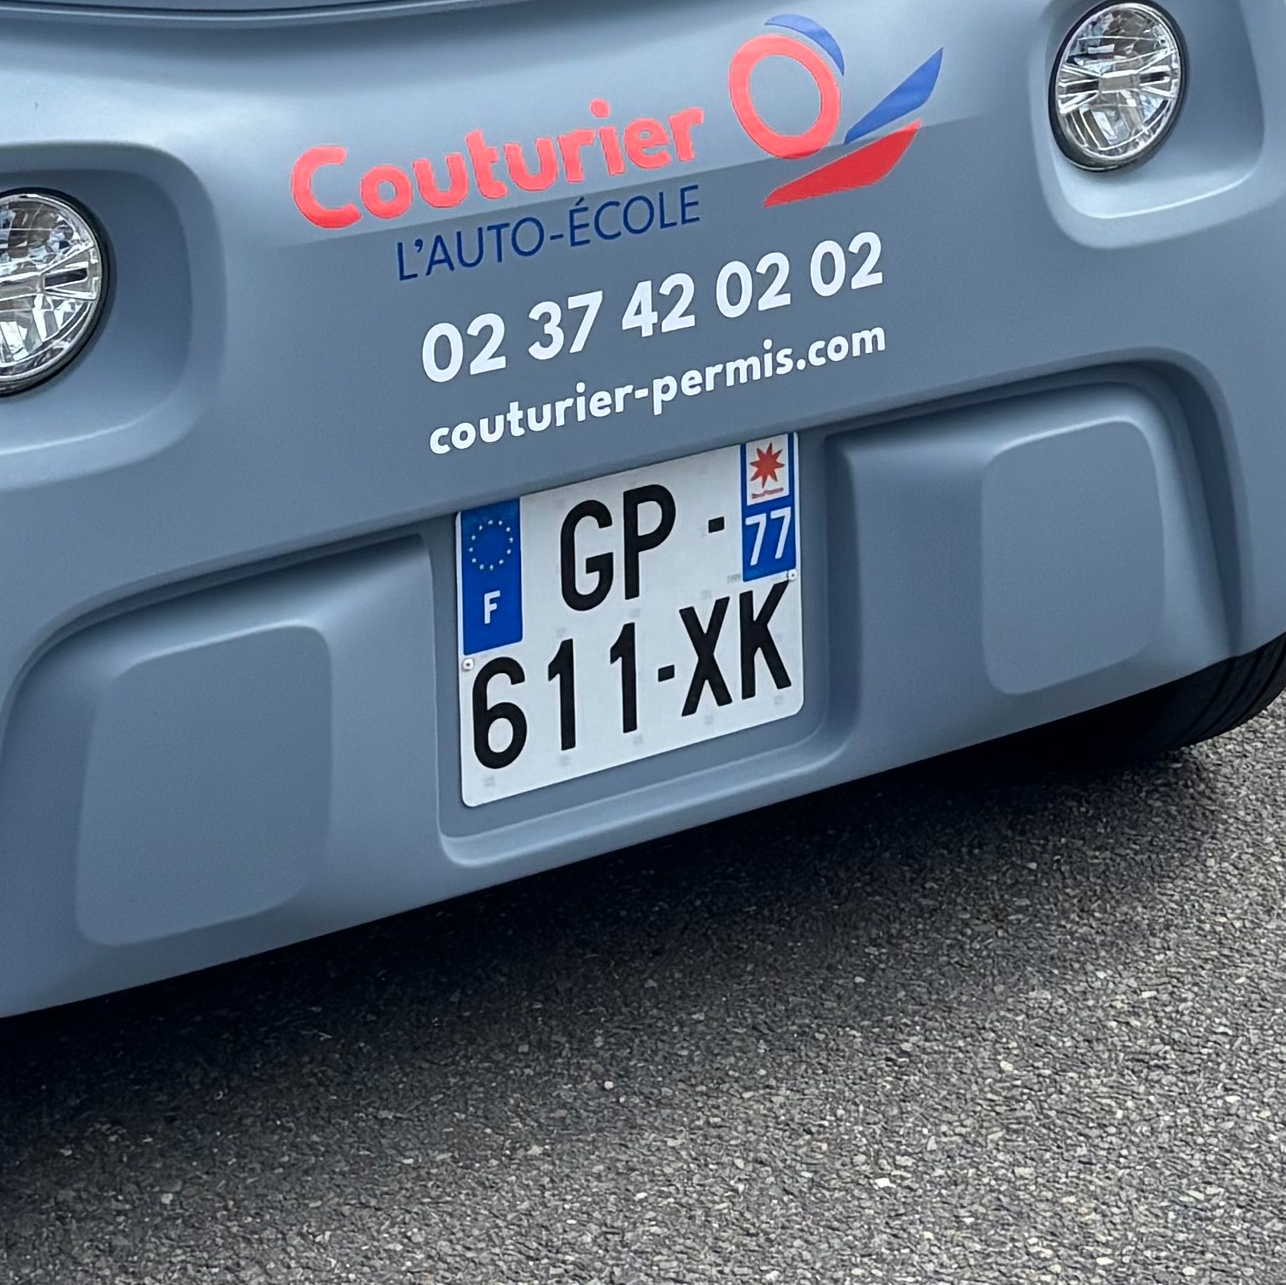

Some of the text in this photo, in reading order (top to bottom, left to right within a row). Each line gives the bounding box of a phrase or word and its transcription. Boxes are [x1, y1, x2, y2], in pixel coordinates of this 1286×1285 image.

[291, 98, 704, 230] Couturier
[421, 231, 884, 382] 02 37 42 02 02
[428, 323, 887, 455] couturier-permis.com
[745, 506, 792, 566] 77
[483, 590, 501, 625] F
[472, 580, 793, 770] 611-XK
